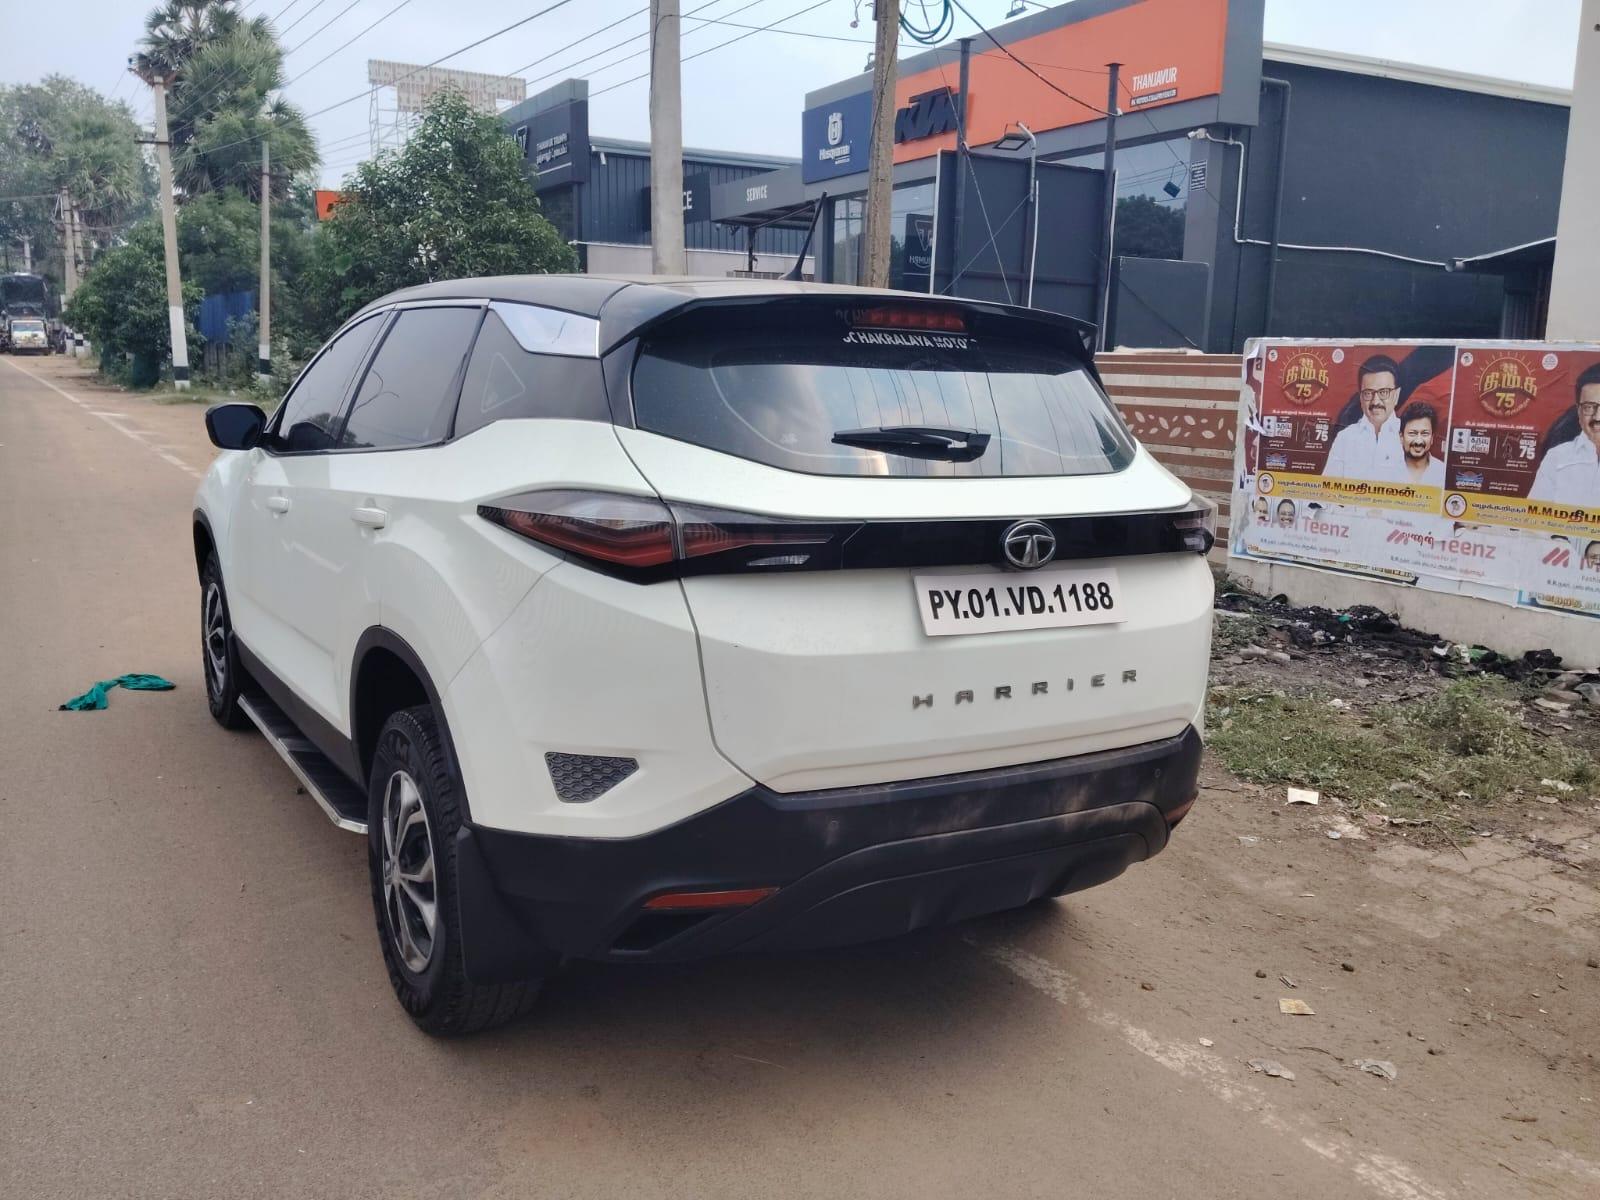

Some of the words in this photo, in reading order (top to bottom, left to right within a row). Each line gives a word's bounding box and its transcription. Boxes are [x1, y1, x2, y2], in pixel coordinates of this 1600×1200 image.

[1132, 66, 1177, 92] THANJAVUR
[894, 86, 961, 144] KTM
[746, 185, 768, 202] SERVICE
[1295, 383, 1312, 397] 75
[1495, 392, 1516, 408] 75
[1315, 429, 1329, 442] 75
[1519, 446, 1536, 460] 75
[928, 581, 1114, 620] PY.01.VD.1188
[912, 669, 1137, 709] HARRIER
